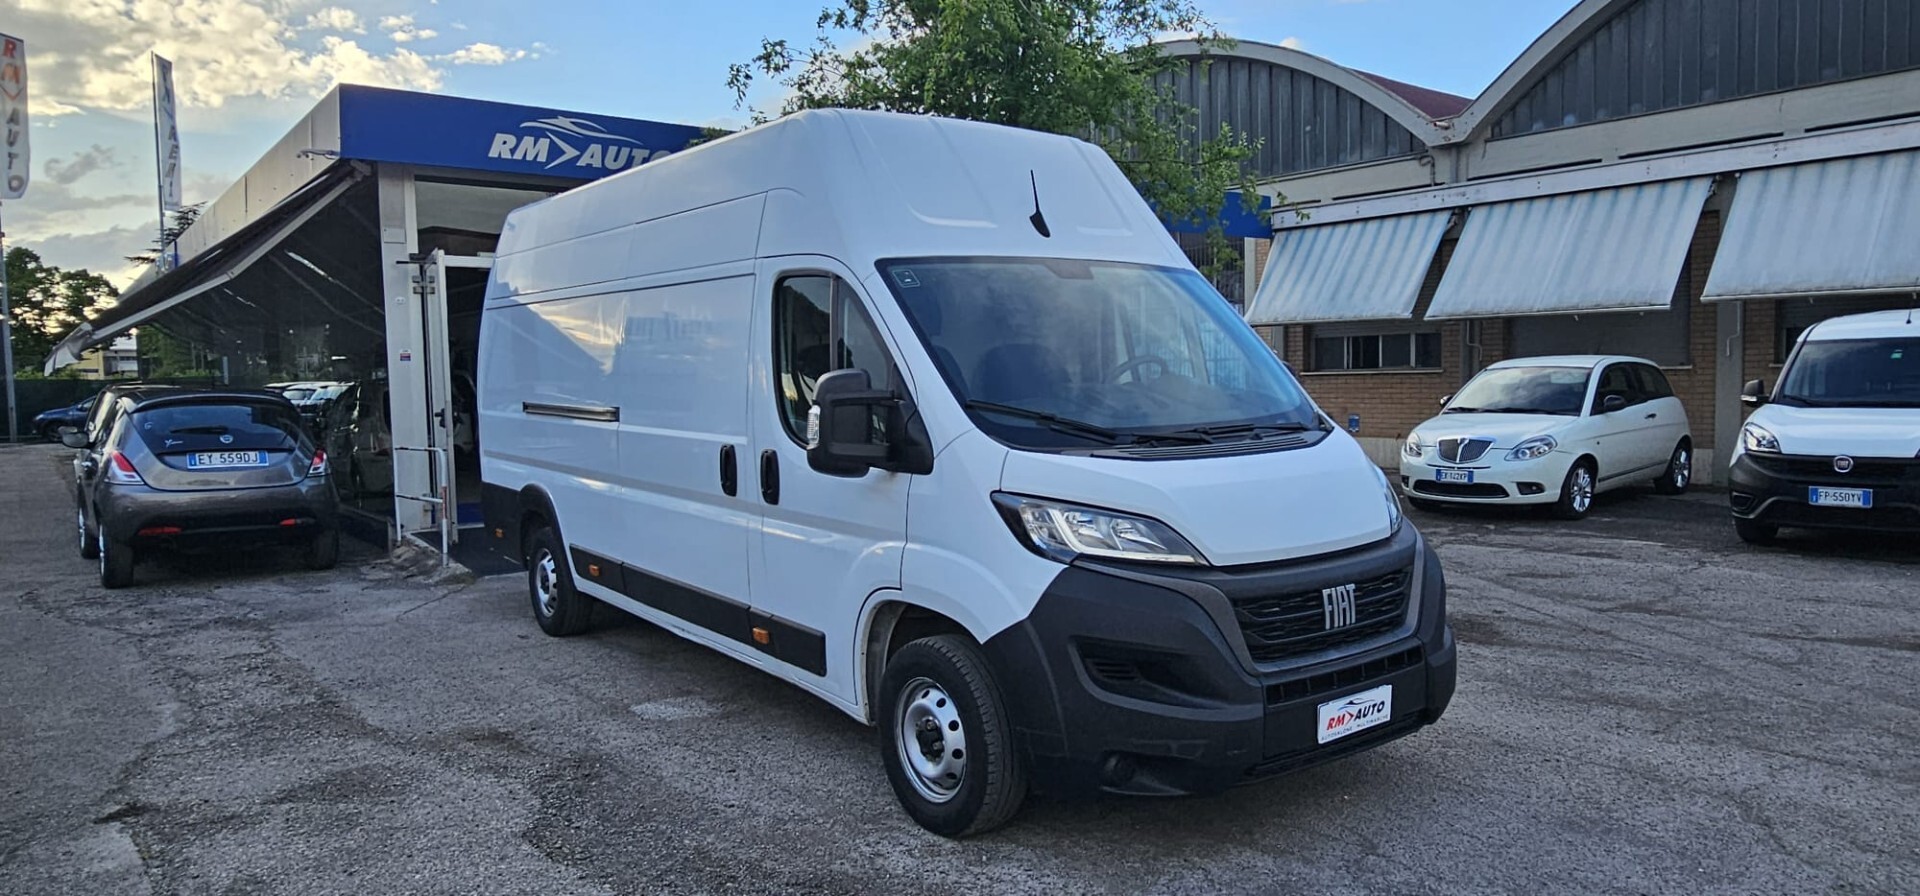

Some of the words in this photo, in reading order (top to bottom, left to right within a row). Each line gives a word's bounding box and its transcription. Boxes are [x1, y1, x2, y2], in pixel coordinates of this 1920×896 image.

[6, 107, 25, 193] AUTO
[488, 133, 550, 162] RM
[1322, 583, 1356, 630] FIAT
[1326, 713, 1346, 731] RM
[1353, 700, 1385, 721] AUTO
